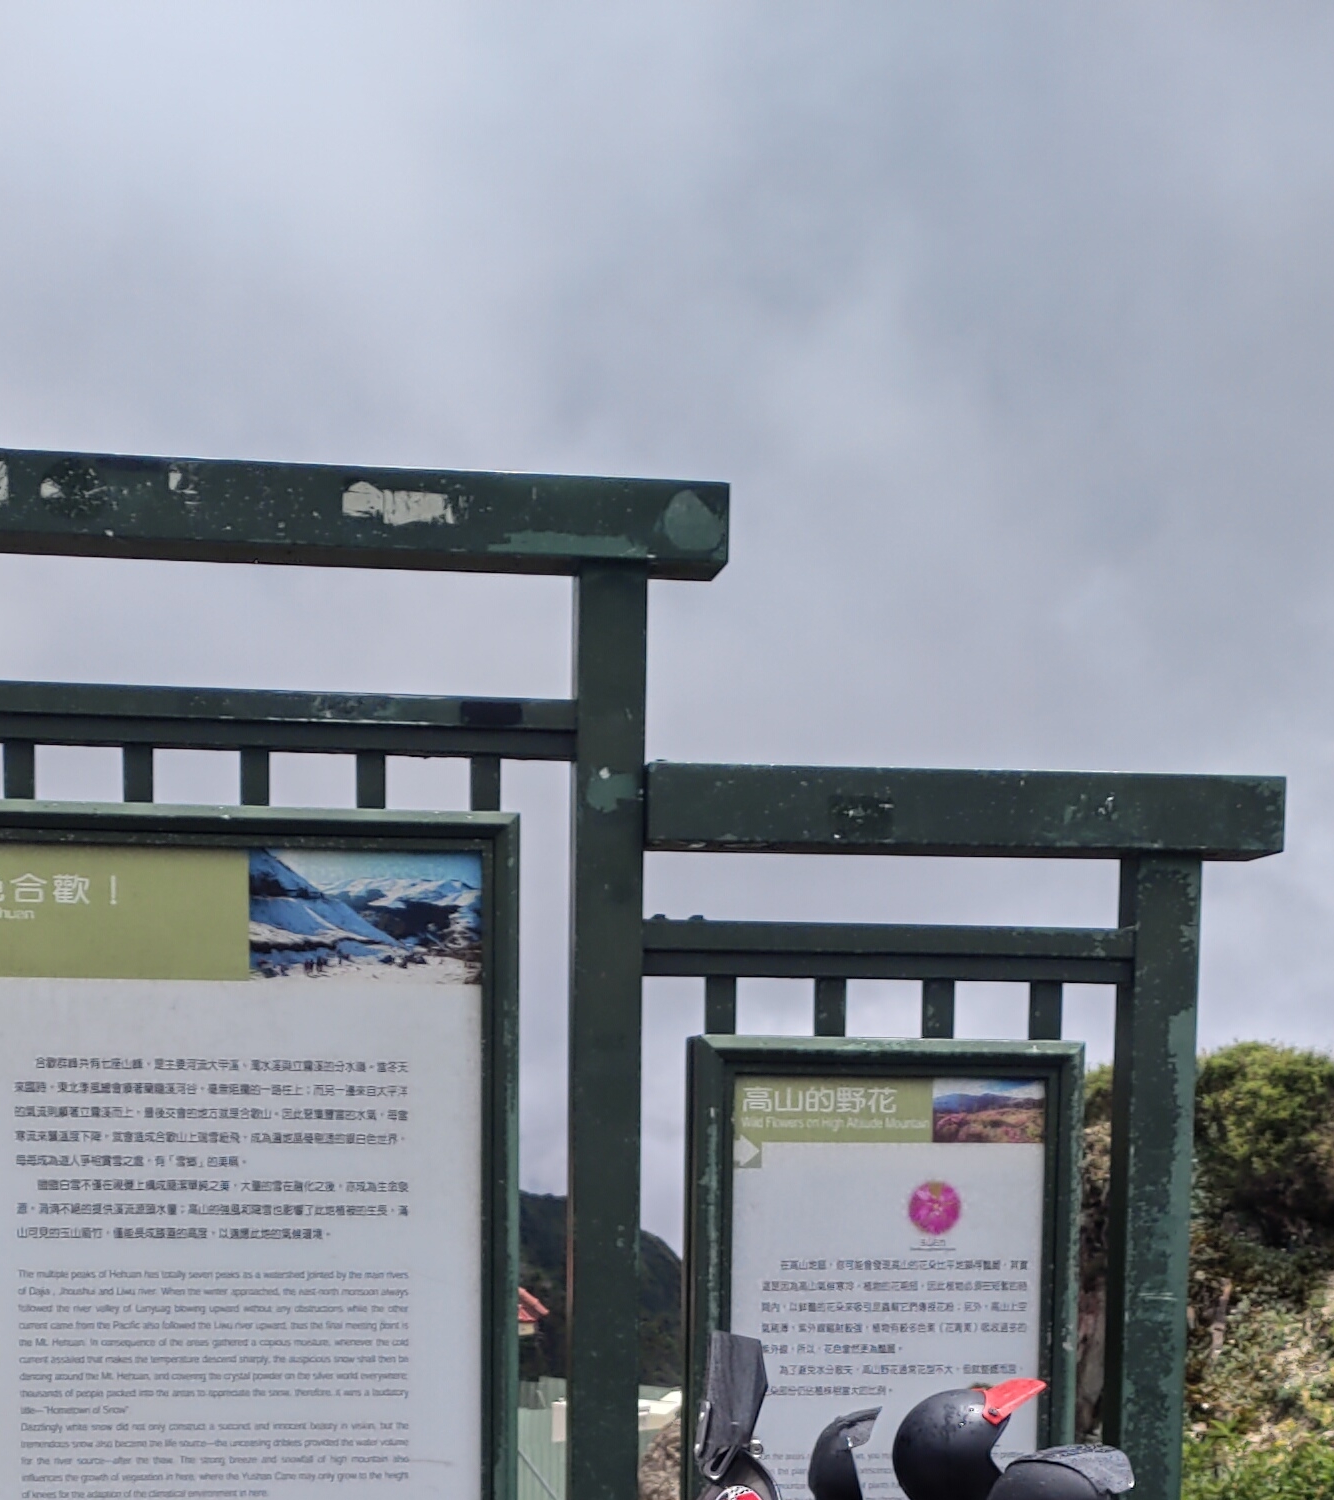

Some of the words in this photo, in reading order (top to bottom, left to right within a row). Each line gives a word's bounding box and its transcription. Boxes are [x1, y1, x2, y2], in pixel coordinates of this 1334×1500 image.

[742, 1086, 898, 1113] 高山的野花
[766, 1117, 804, 1128] Flowers
